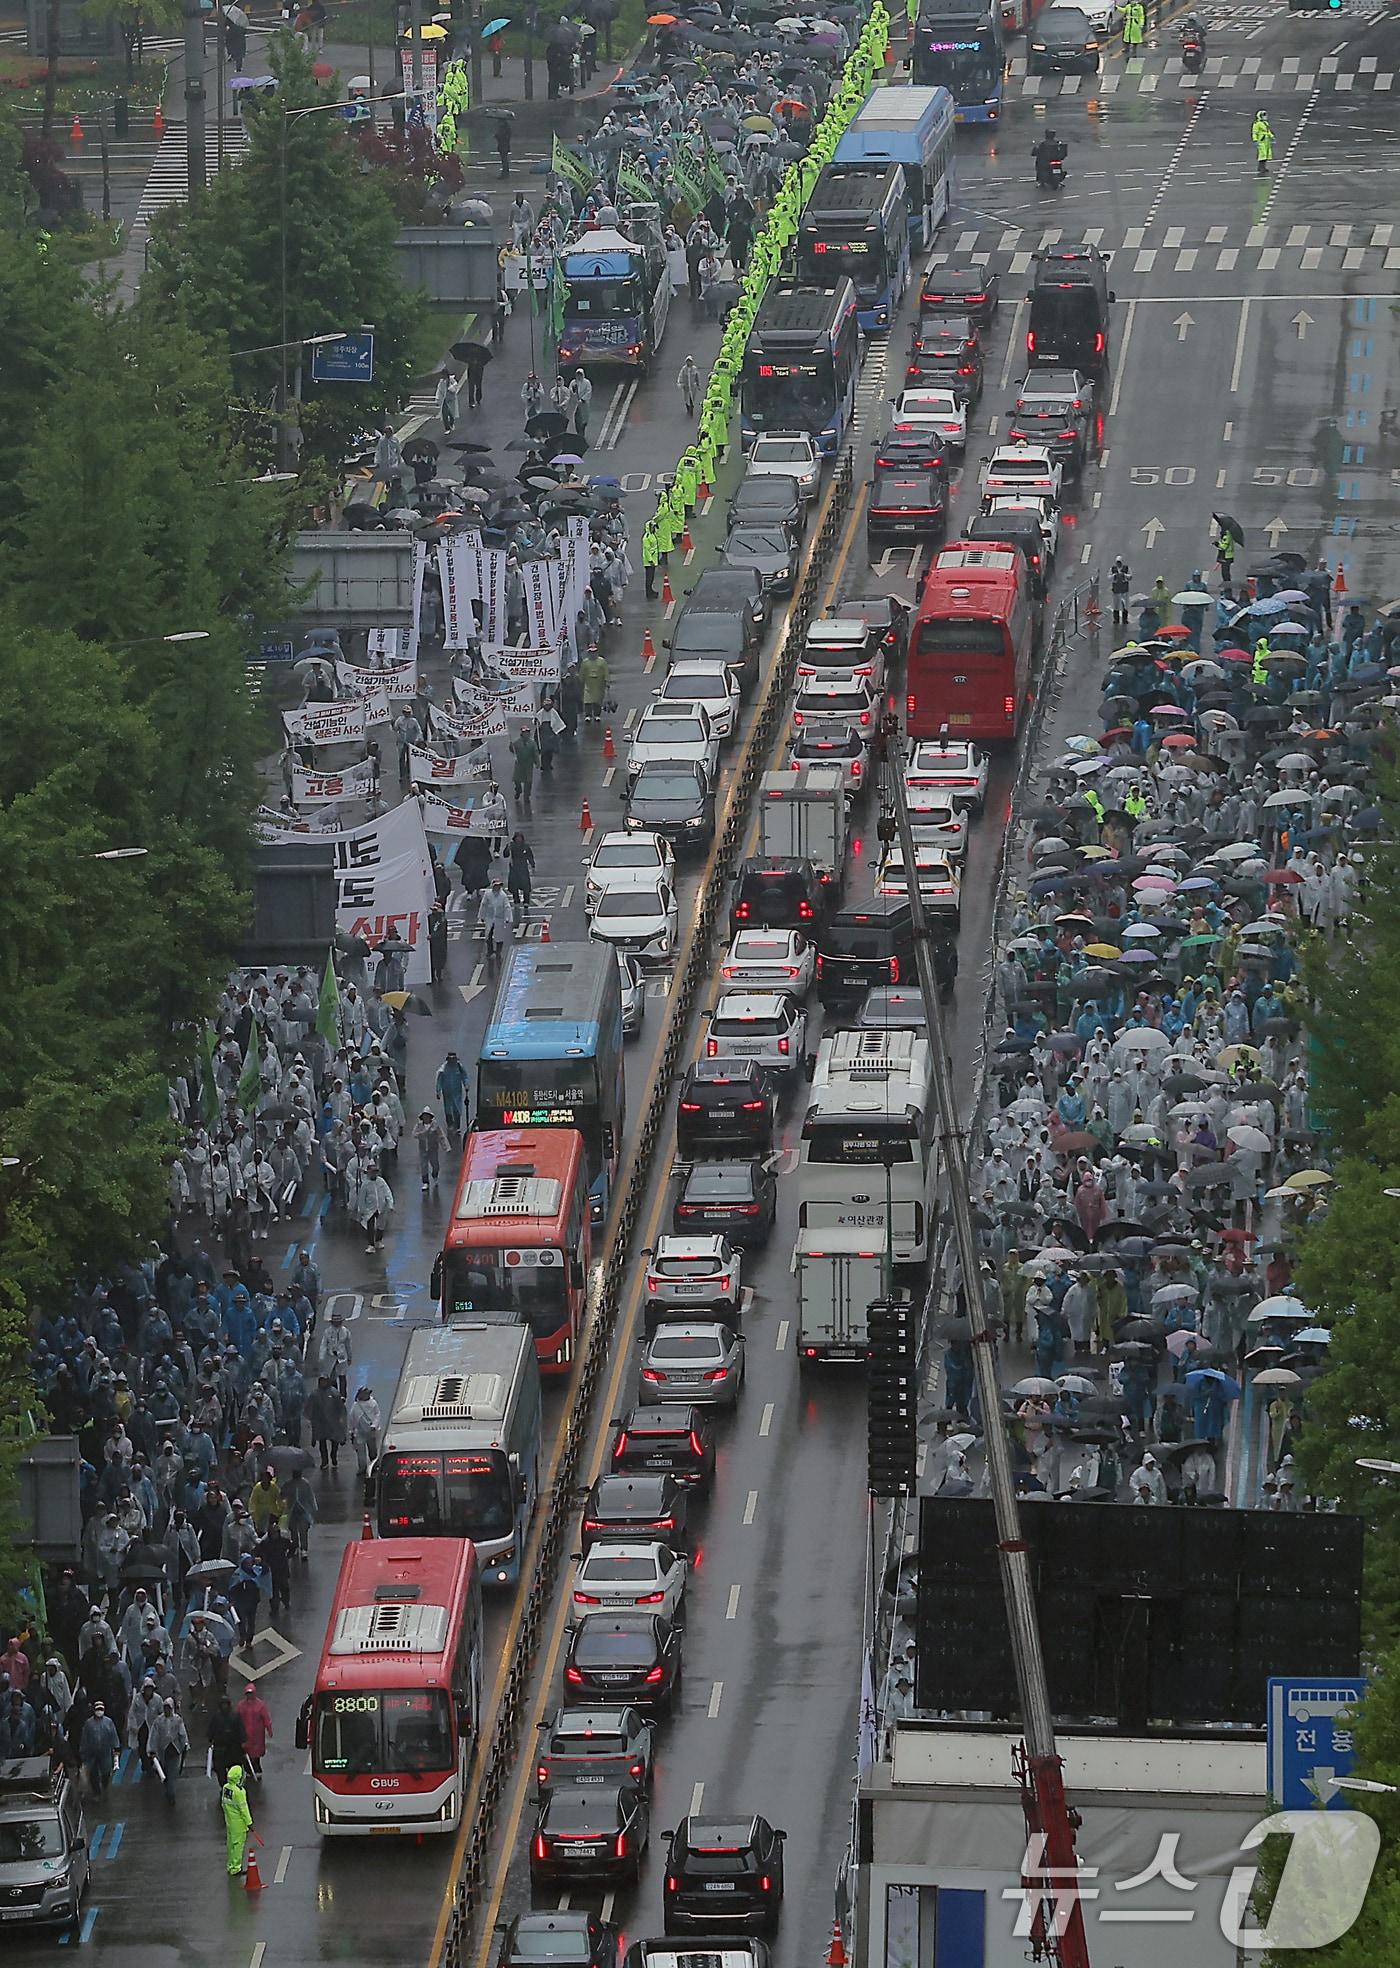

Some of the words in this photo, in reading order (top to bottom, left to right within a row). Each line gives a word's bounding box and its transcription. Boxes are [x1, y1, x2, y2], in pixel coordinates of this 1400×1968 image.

[760, 365, 772, 377] 105
[1129, 466, 1196, 486] 50
[1249, 466, 1319, 487] 50
[431, 759, 457, 778] 일
[304, 777, 344, 797] 고용
[446, 808, 473, 829] 일
[496, 1090, 529, 1107] M4108
[565, 1088, 584, 1100] 서울역
[503, 1110, 531, 1124] M4108
[323, 1293, 411, 1321] 50
[334, 1696, 378, 1713] 8800
[370, 1778, 400, 1789] GBUS
